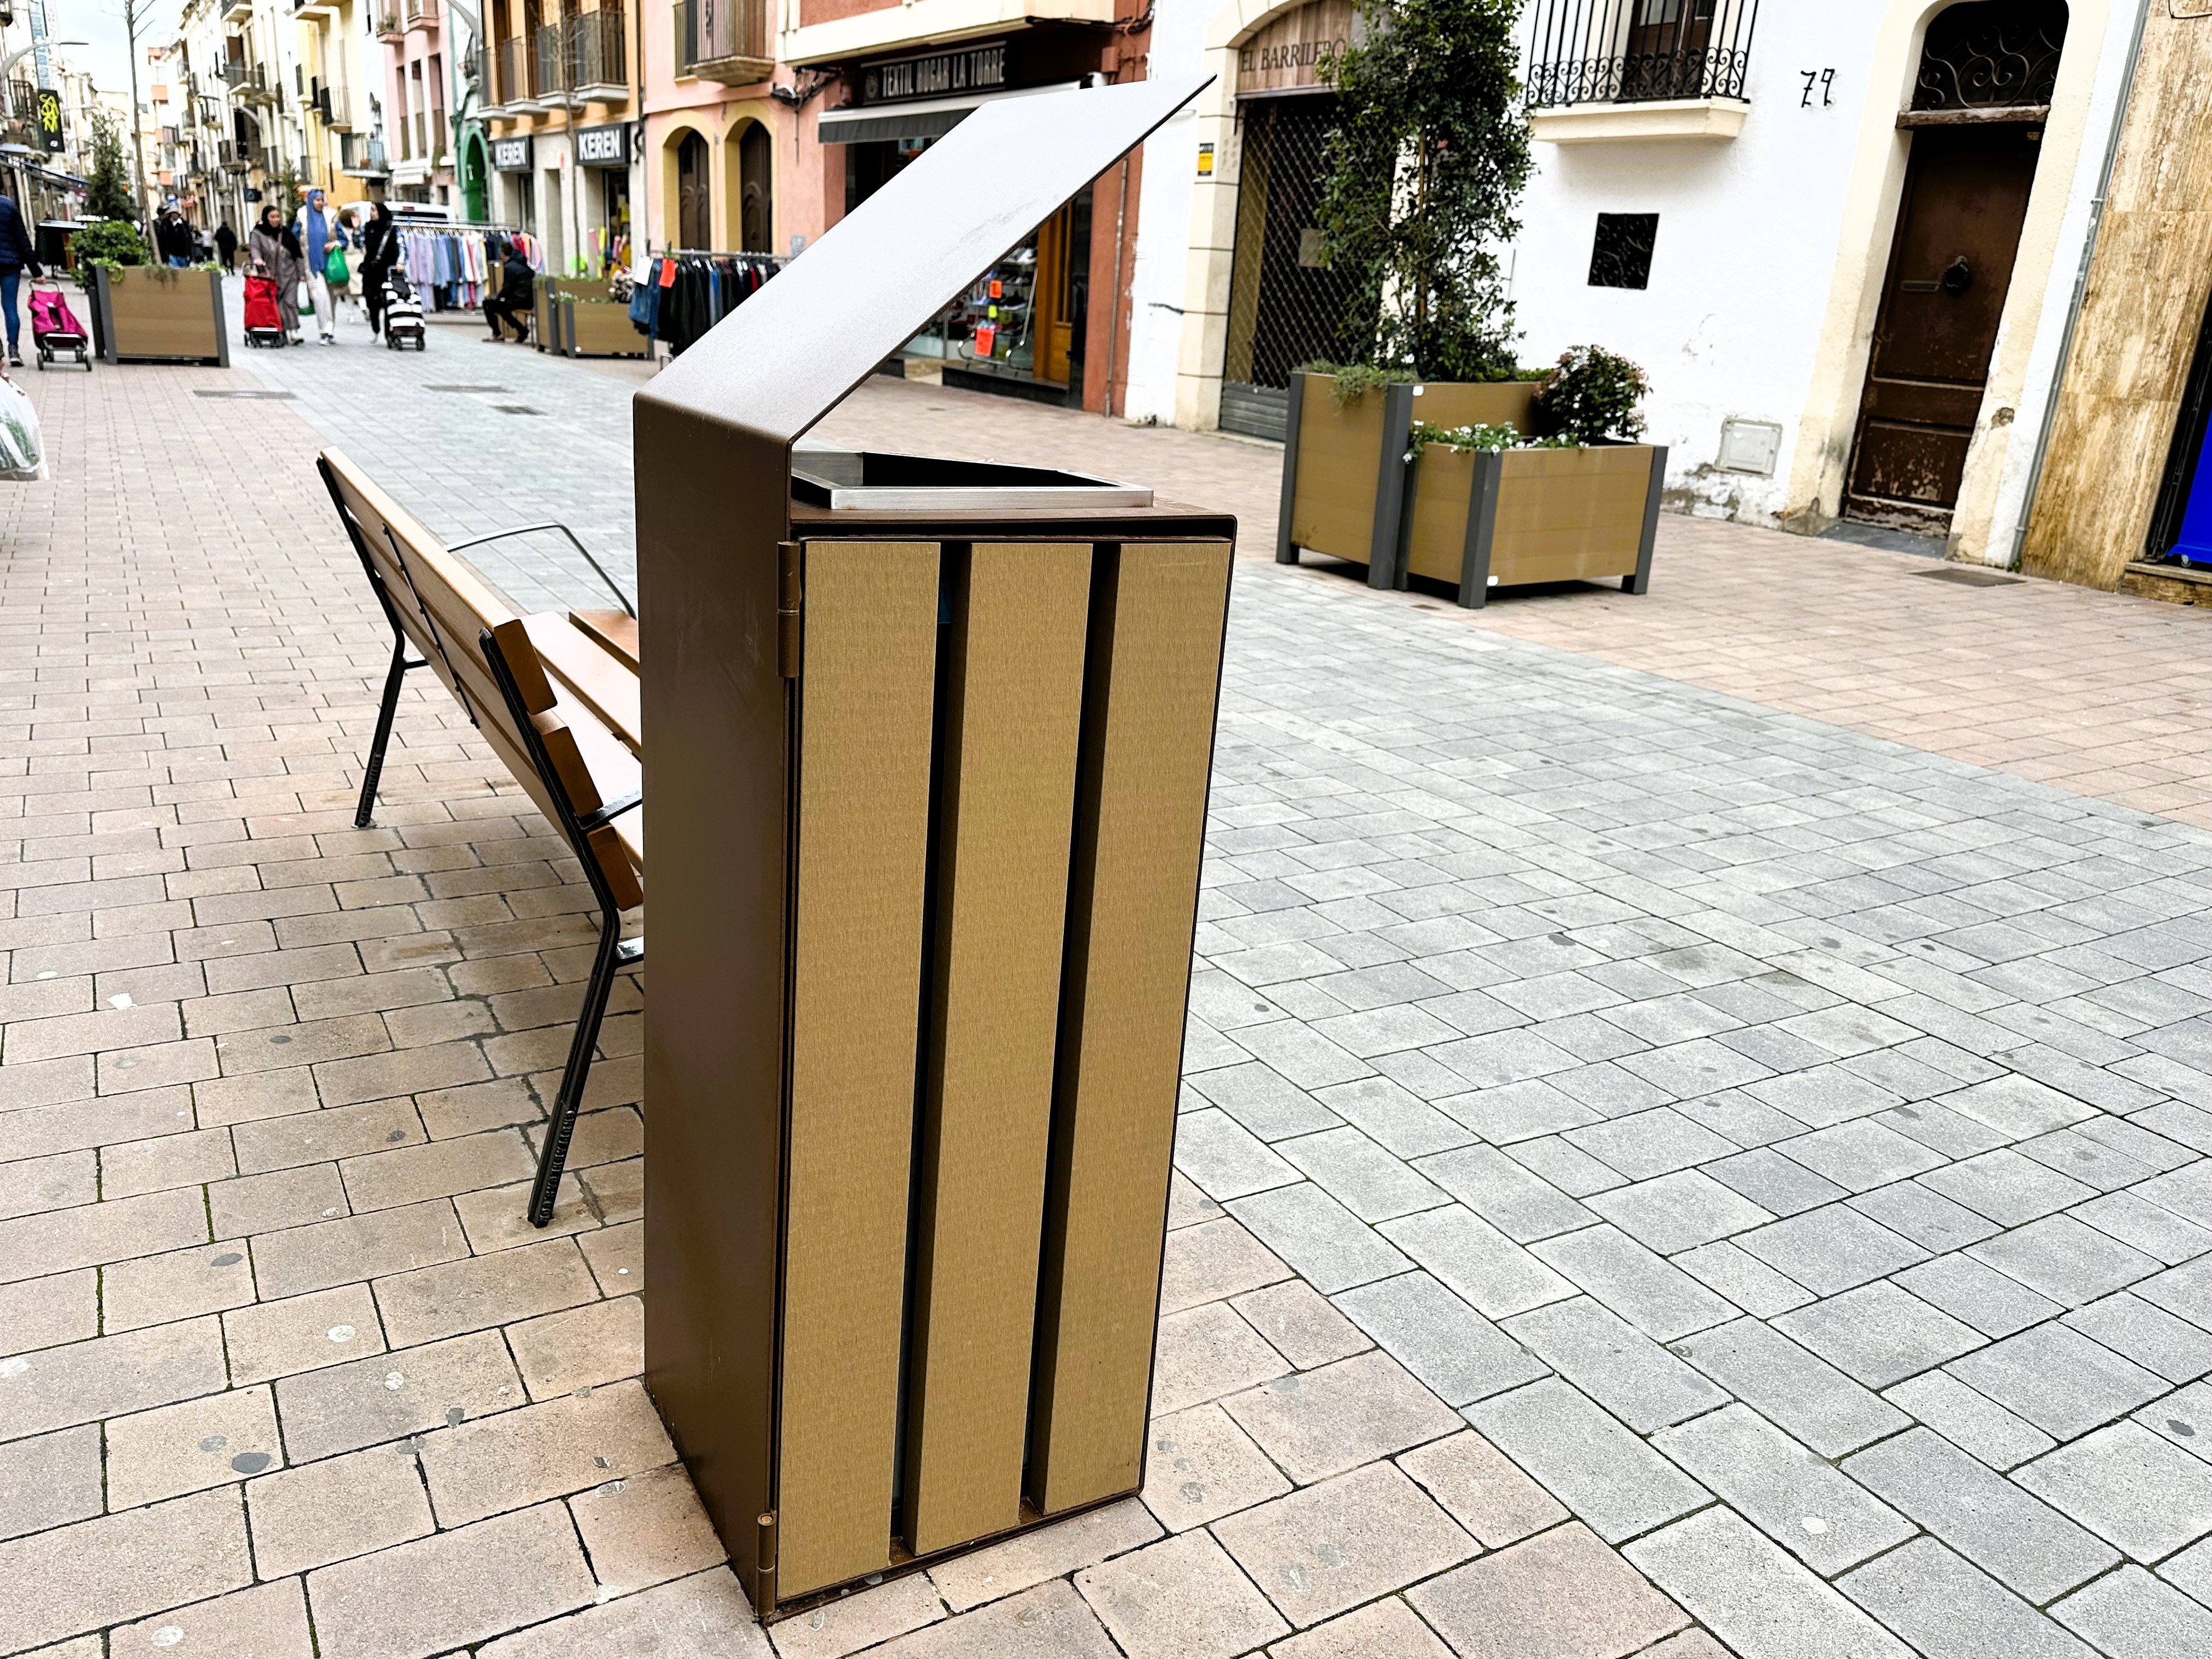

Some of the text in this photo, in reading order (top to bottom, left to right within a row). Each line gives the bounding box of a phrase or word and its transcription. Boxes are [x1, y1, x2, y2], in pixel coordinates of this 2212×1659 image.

[882, 48, 1005, 98] TEXTIL HOGAR LA TORRE
[1241, 49, 1255, 72] EL
[1801, 68, 1835, 108] 79
[495, 140, 526, 166] KEREN
[578, 128, 620, 160] KEREN
